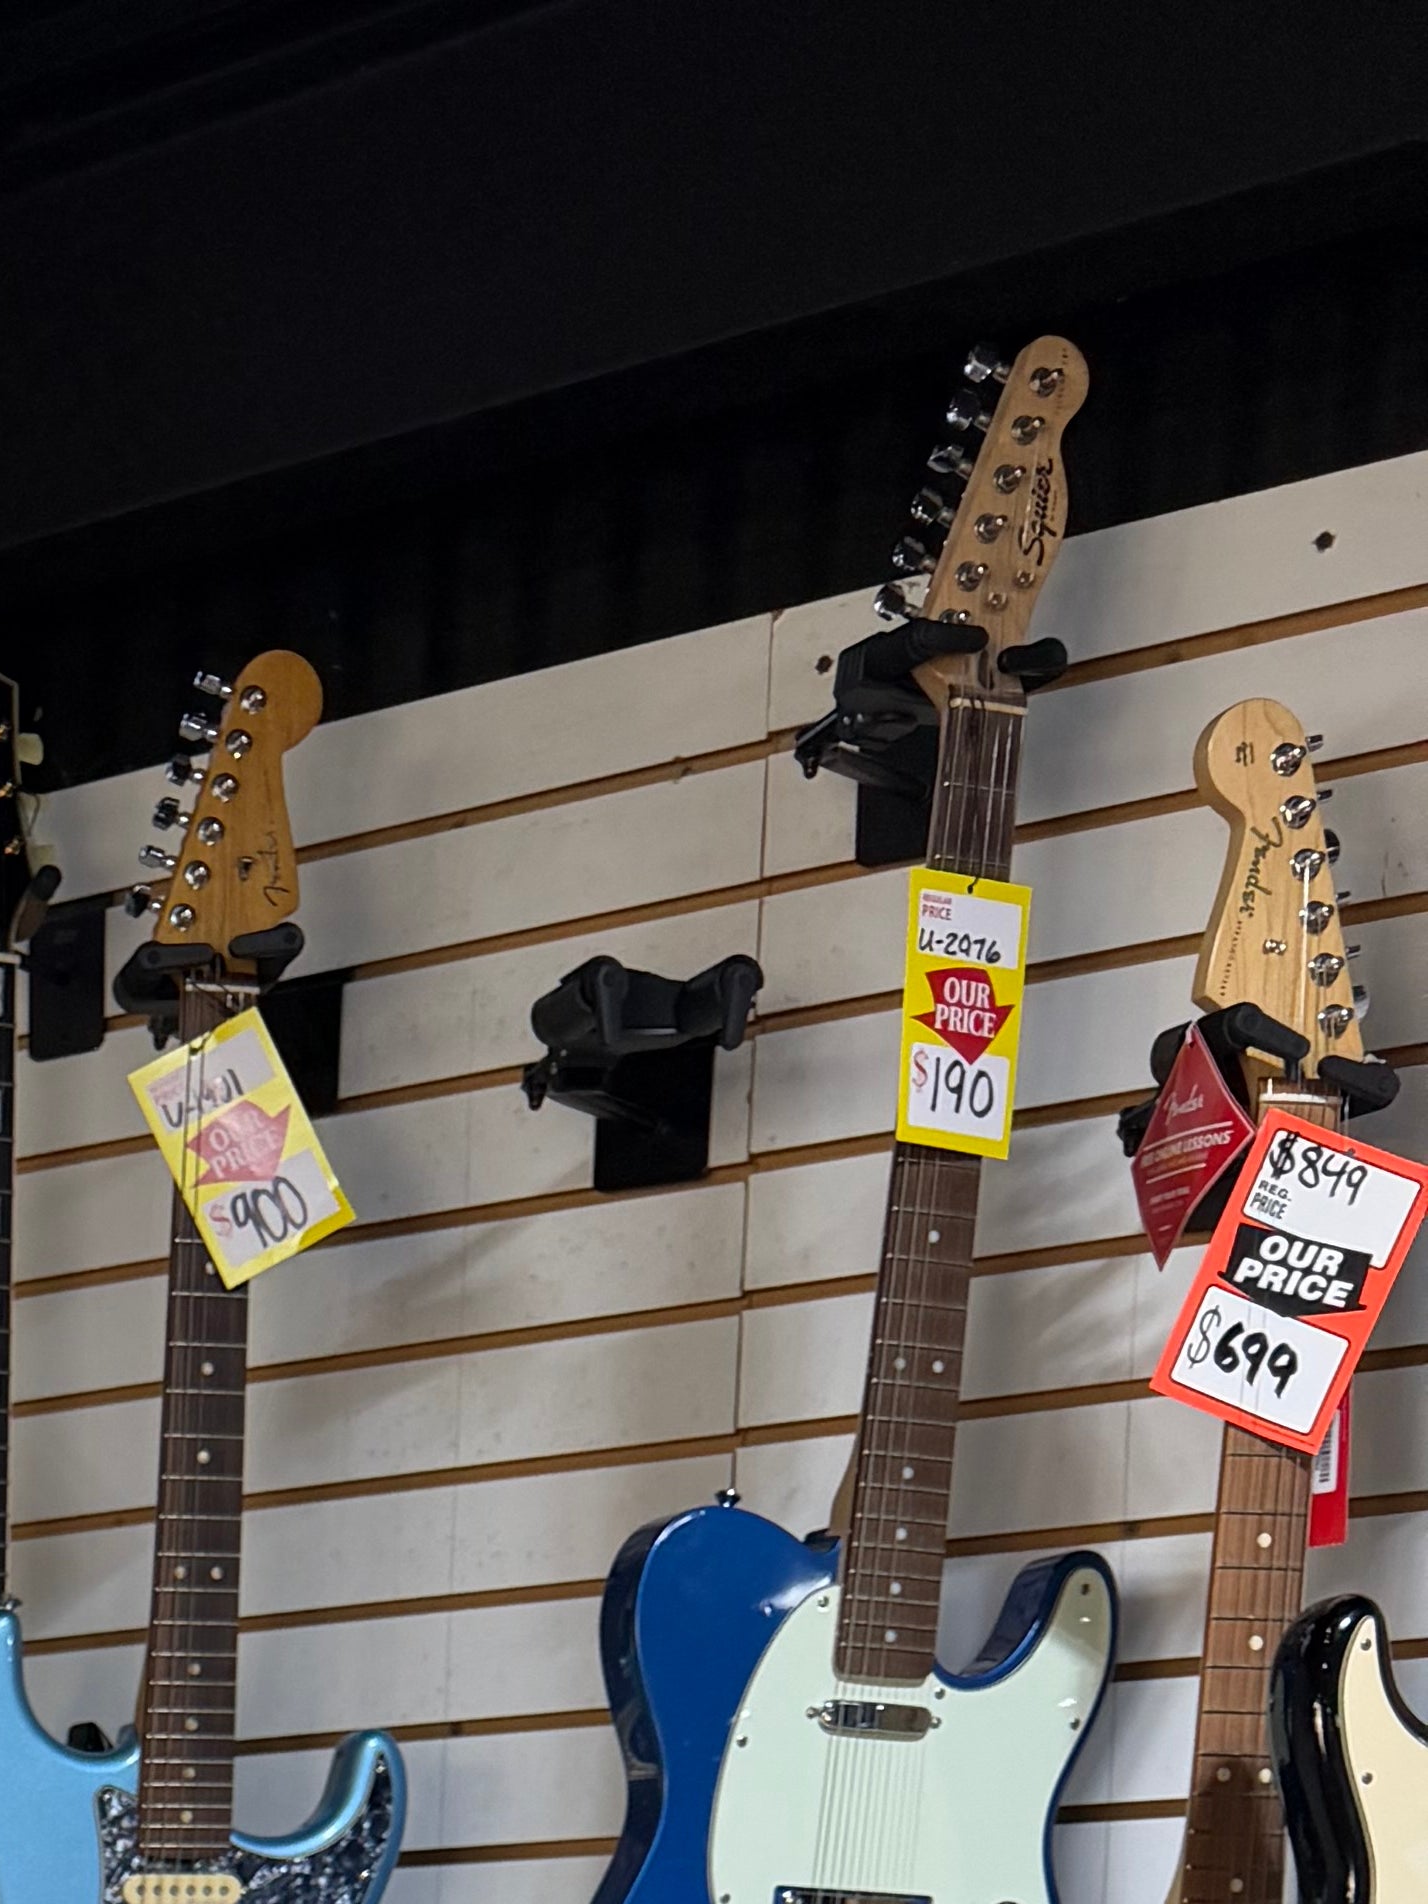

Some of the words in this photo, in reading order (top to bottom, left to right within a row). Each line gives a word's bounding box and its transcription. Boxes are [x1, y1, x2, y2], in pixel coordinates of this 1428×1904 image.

[1017, 457, 1059, 567] Squier
[1238, 815, 1284, 919] Fender
[921, 903, 953, 922] PRICE
[943, 975, 991, 1010] OUR
[934, 1003, 997, 1039] PRICE
[911, 1048, 995, 1119] $190
[1182, 1128, 1236, 1154] LESSONS
[1257, 1179, 1293, 1203] REG.
[1269, 1130, 1369, 1207] $849
[209, 1175, 308, 1248] $900
[1249, 1191, 1289, 1221] PRICE
[1259, 1234, 1345, 1277] OUR
[1232, 1257, 1354, 1309] PRICE
[1185, 1303, 1299, 1400] $699
